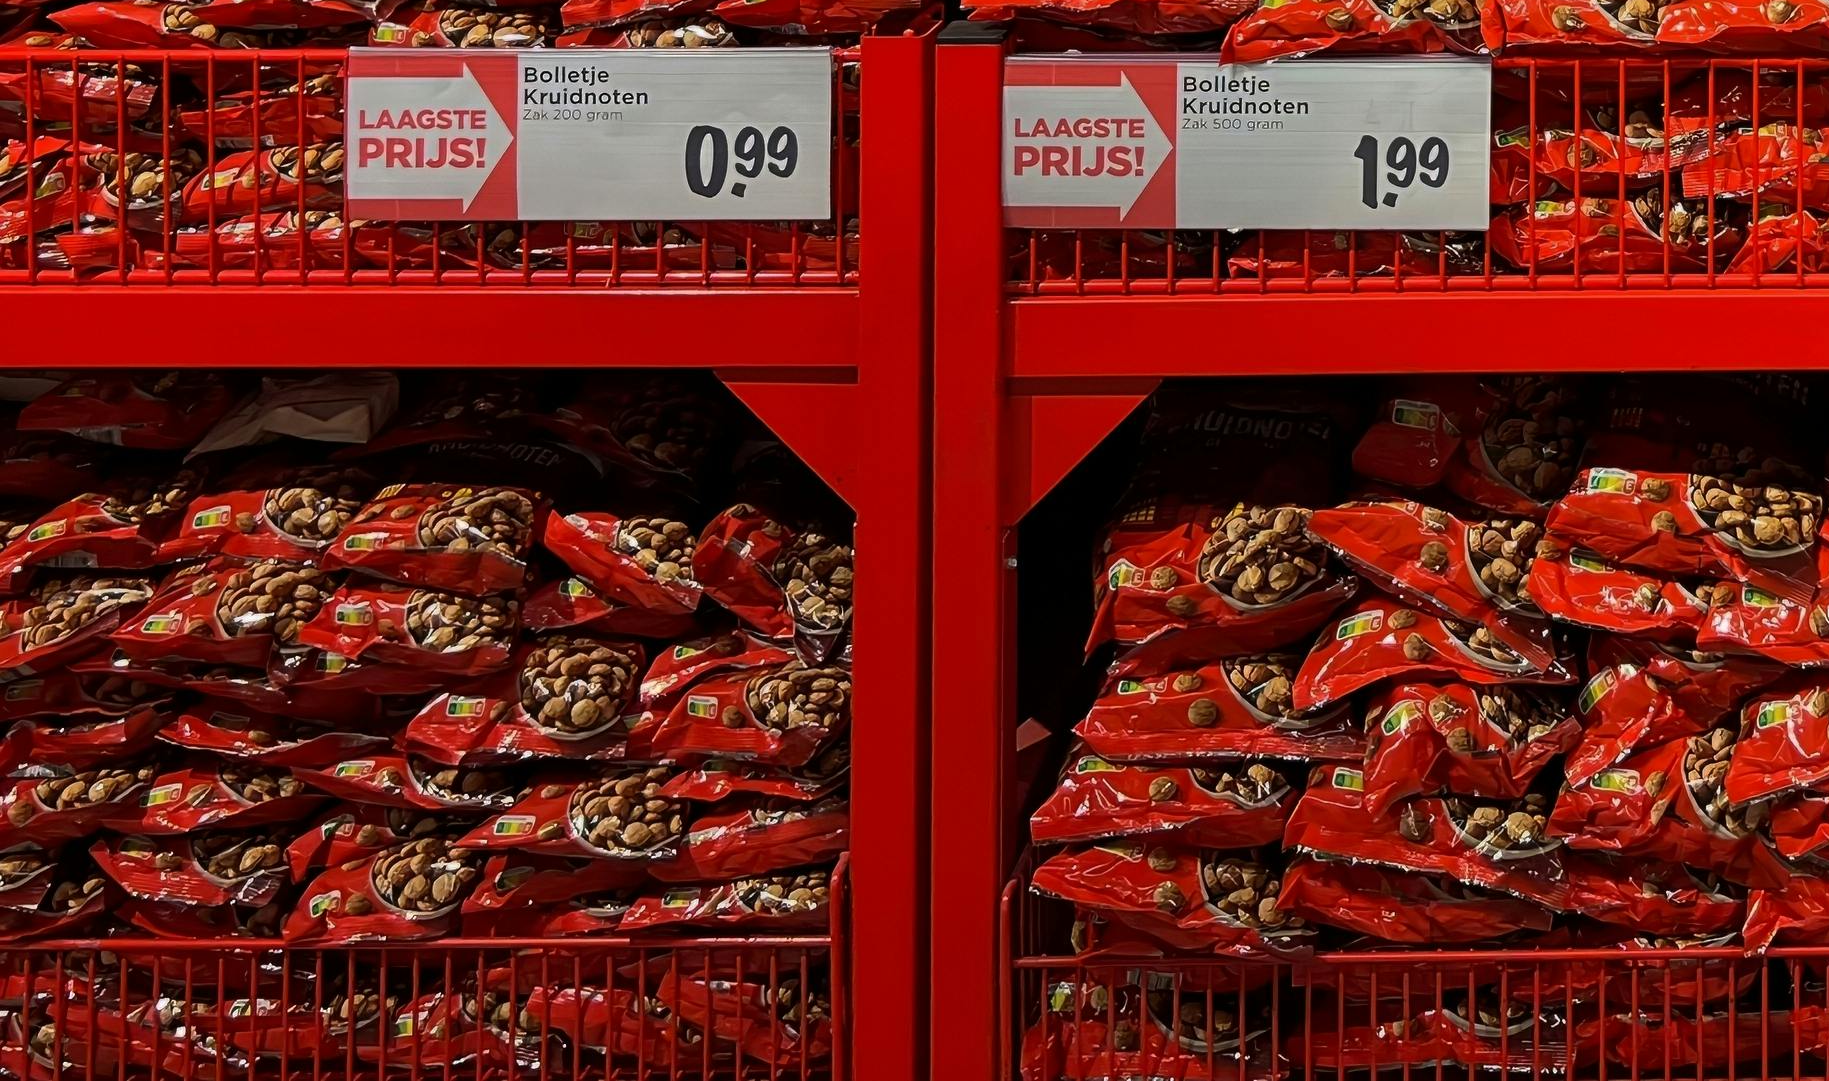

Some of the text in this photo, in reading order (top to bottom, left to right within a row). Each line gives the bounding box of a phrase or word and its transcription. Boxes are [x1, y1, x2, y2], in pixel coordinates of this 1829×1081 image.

[524, 66, 610, 85] Bolletje
[1182, 76, 1270, 95] Bolletje
[524, 88, 649, 106] Kruidnoten
[1182, 98, 1310, 115] Kruidnoten
[359, 109, 487, 130] LAAGSTE
[523, 109, 623, 123] Zak 200 gram
[1182, 118, 1284, 132] Zak 500 gram
[1013, 117, 1145, 138] LAAGSTE
[358, 137, 487, 169] PRIJS!
[1013, 145, 1145, 177] PRIJS!
